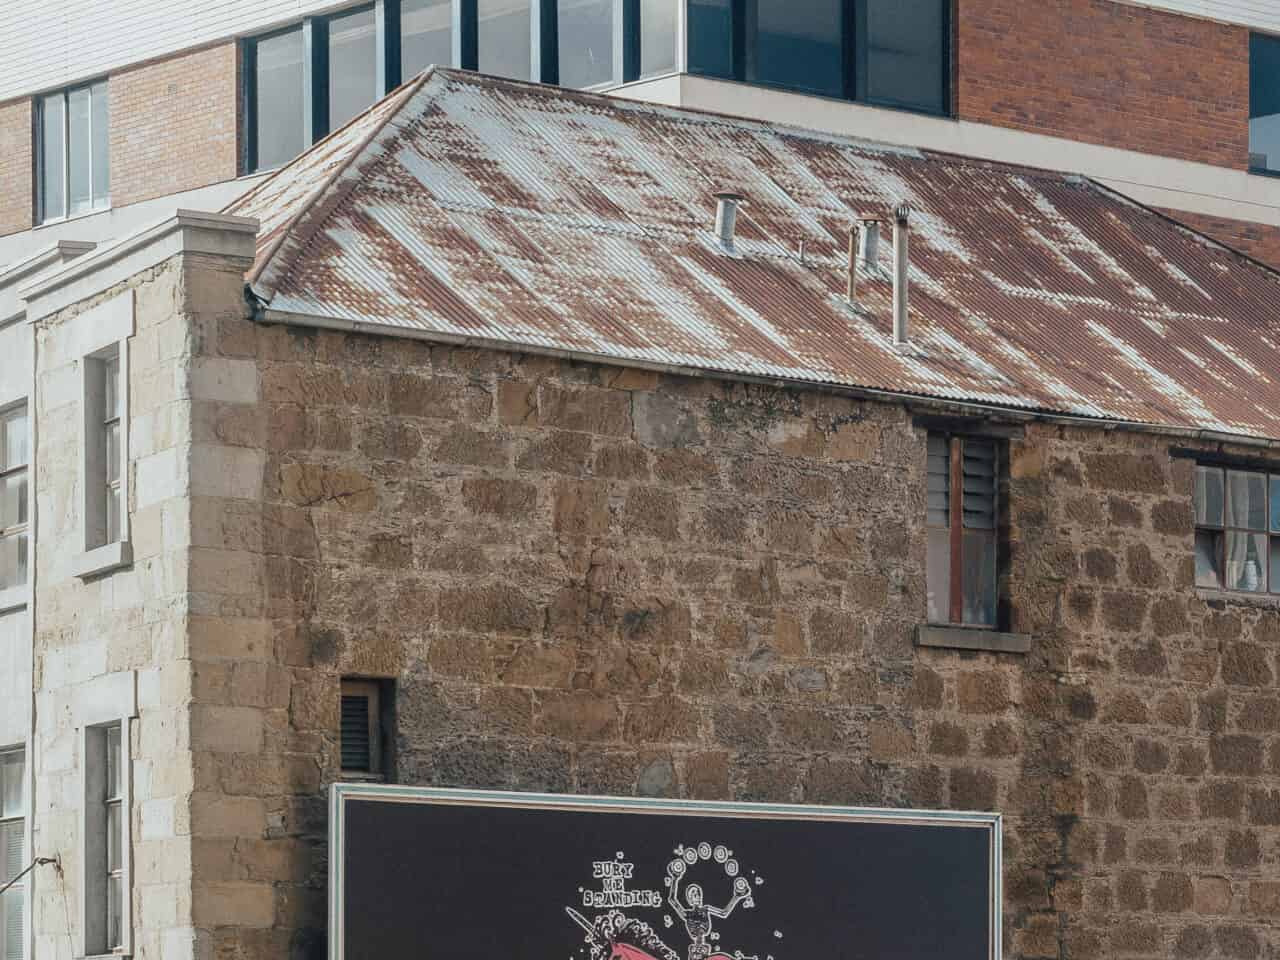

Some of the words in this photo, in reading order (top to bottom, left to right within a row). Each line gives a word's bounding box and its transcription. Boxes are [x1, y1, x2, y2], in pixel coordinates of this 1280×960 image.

[593, 861, 634, 878] BURY
[603, 878, 624, 893] ME
[583, 890, 662, 907] STANDING
